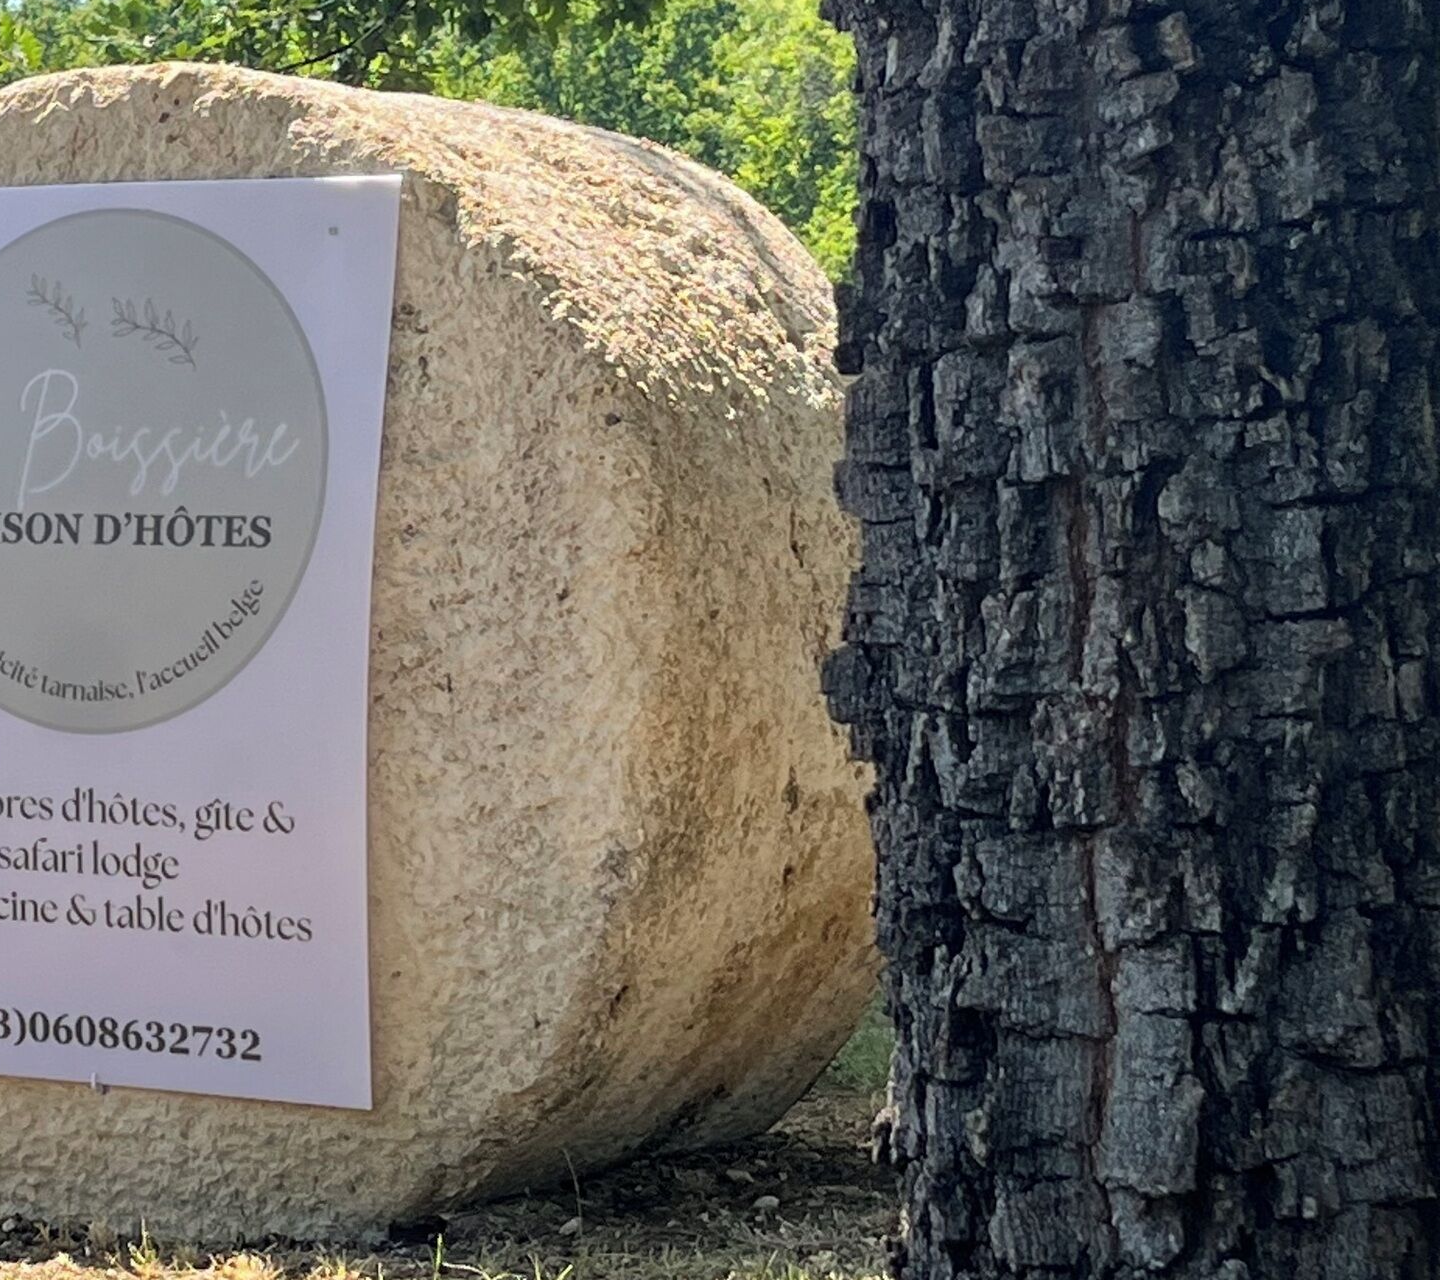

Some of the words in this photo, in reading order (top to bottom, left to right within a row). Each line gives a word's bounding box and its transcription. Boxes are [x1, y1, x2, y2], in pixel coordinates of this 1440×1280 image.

[16, 368, 300, 510] Boissière
[94, 506, 272, 549] D’HÔTES
[41, 675, 135, 702] tarnaise,
[136, 629, 221, 695] l'accueil
[220, 579, 264, 641] belge
[61, 787, 187, 834] d'hôtes,
[194, 800, 254, 841] gîte
[262, 801, 296, 834] &
[91, 841, 181, 889] lodge
[66, 893, 97, 926] &
[104, 896, 184, 934] table
[192, 900, 313, 943] d'hôtes
